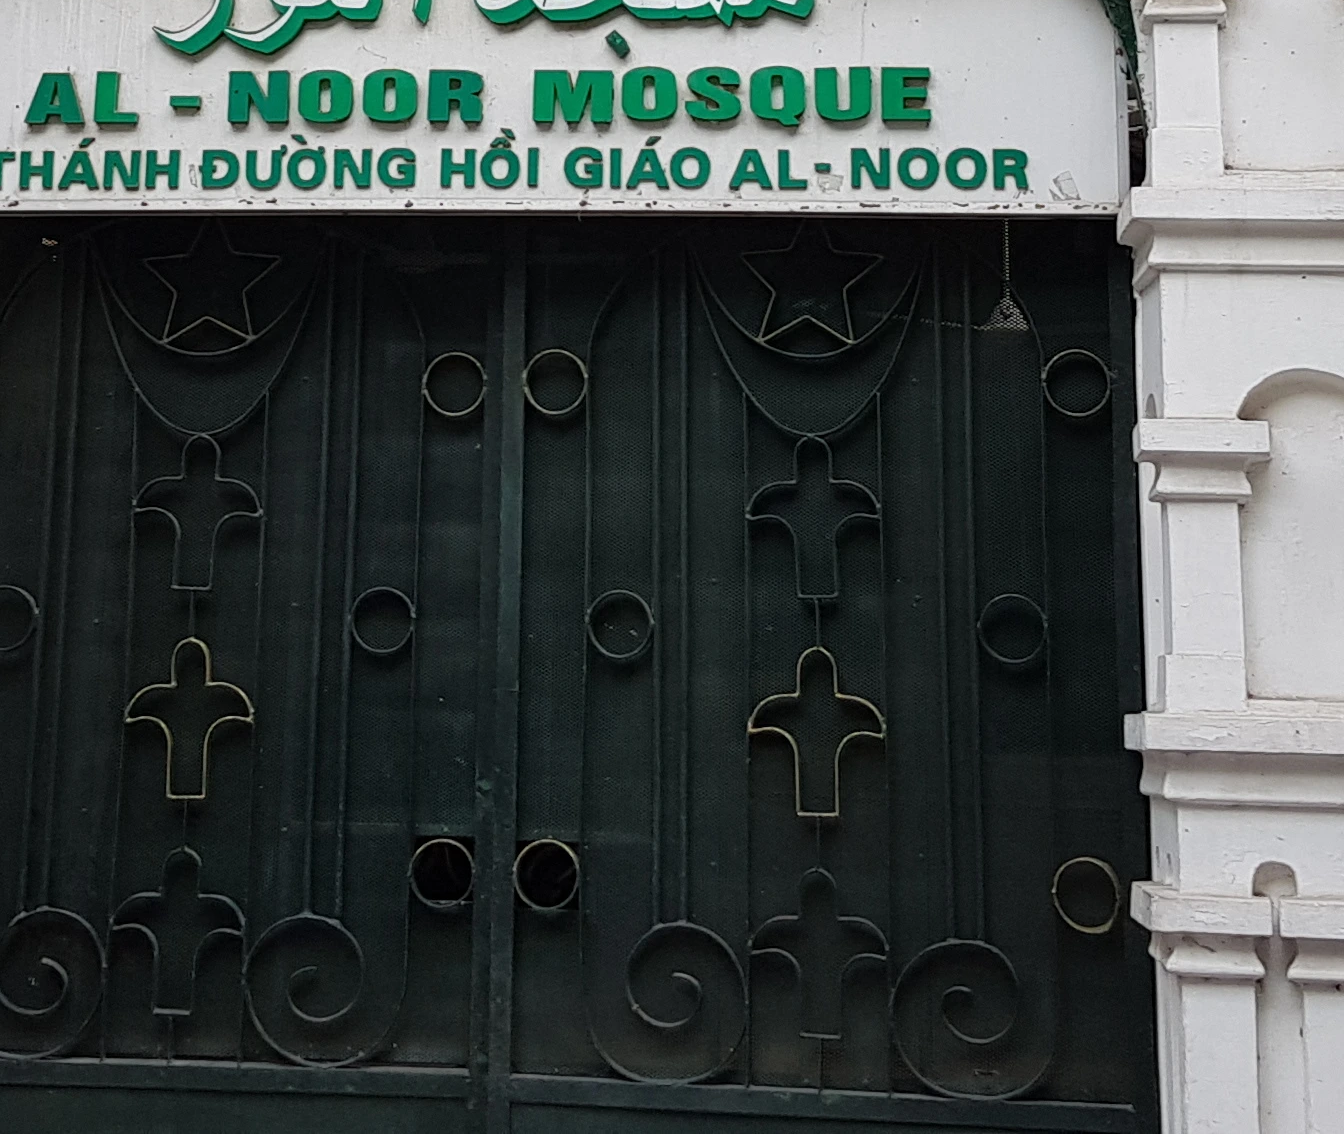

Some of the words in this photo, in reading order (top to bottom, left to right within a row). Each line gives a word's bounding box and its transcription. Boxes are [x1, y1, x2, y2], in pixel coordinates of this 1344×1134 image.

[25, 70, 139, 125] AL
[227, 69, 485, 125] NOOR
[532, 66, 932, 127] MOSQUE
[199, 134, 416, 190] ĐƯỜNG
[440, 128, 539, 189] HỒI
[563, 135, 712, 190] GIÁO
